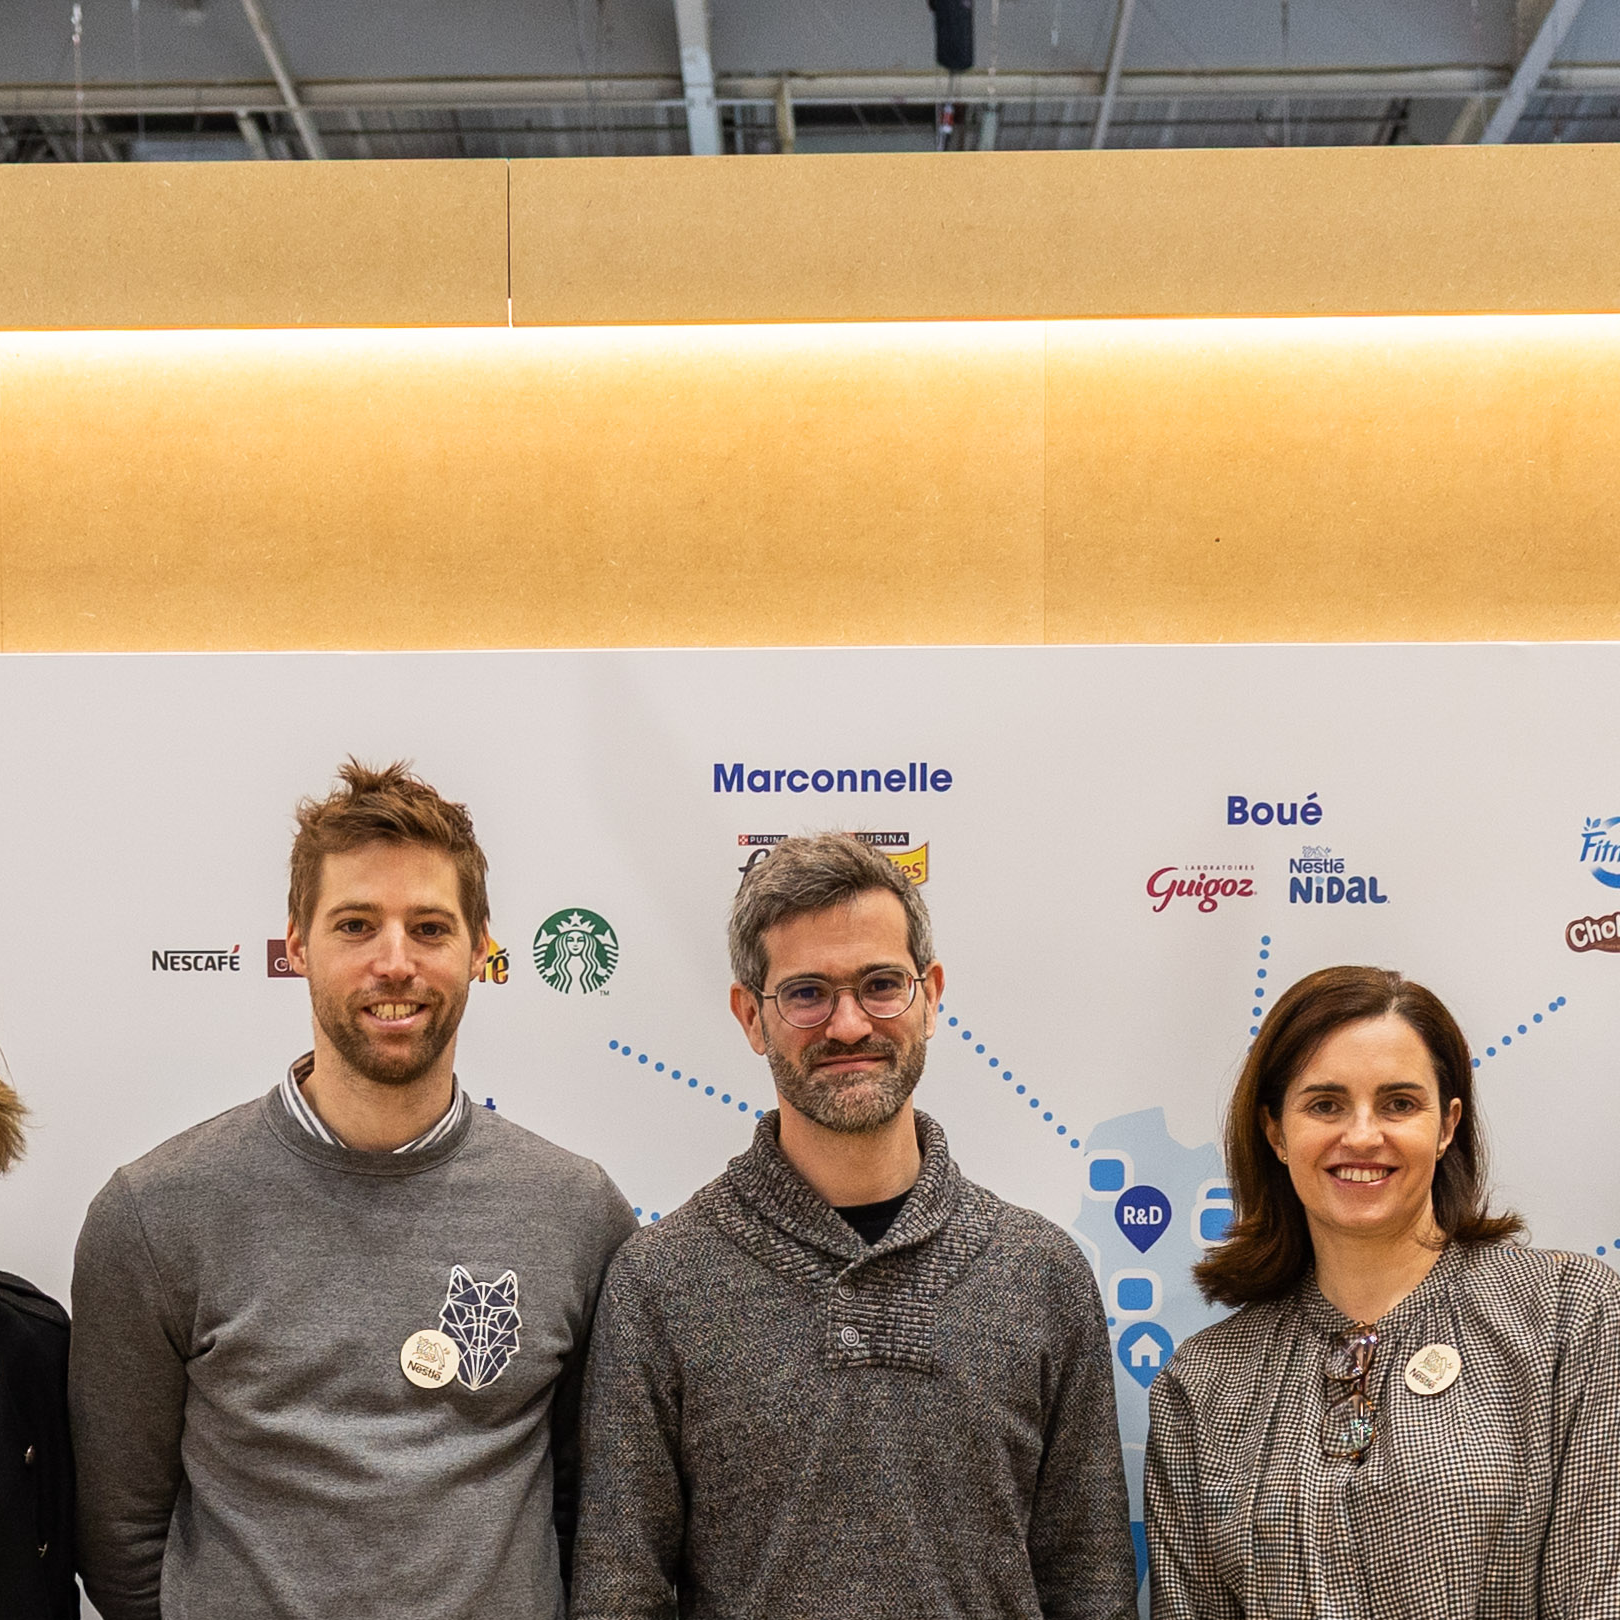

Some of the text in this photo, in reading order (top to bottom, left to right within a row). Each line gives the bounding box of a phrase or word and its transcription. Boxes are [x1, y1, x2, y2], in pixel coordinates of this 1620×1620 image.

[714, 763, 953, 793] Marconnelle
[1227, 792, 1323, 825] Boué
[1290, 858, 1345, 873] Nestlé
[1146, 867, 1255, 913] Guigoz
[152, 945, 241, 971] NESCAFÉ
[1123, 1205, 1163, 1226] R&D
